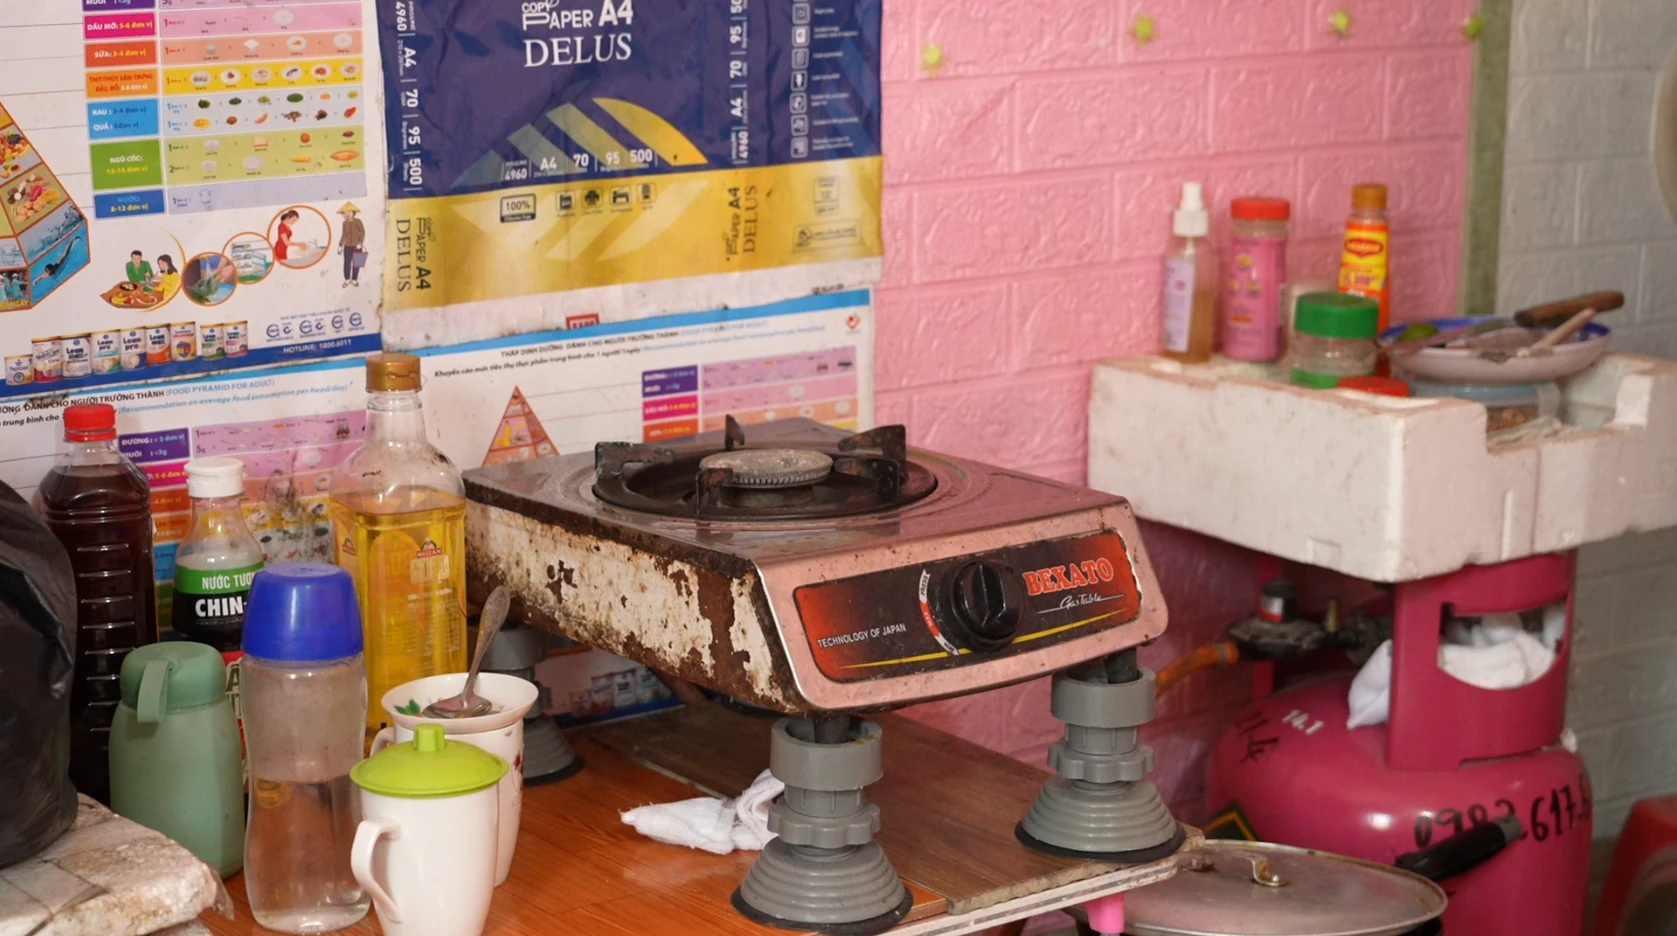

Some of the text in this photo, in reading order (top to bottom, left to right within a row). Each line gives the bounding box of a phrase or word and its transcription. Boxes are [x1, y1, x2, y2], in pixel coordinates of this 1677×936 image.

[522, 0, 634, 31] PAPER A4
[730, 25, 742, 44] 95
[404, 47, 417, 68] A4
[523, 32, 633, 67] DELUS
[729, 60, 742, 79] 70
[406, 89, 419, 108] 70
[730, 97, 743, 117] A4
[408, 126, 421, 145] 95
[540, 157, 557, 171] A4
[573, 153, 589, 167] 70
[605, 152, 620, 165] 95
[630, 149, 653, 163] 500
[409, 158, 423, 185] 500
[504, 168, 527, 181] 4960
[506, 201, 531, 211] 100%
[728, 186, 741, 209] A4
[743, 185, 758, 253] DELUS
[396, 218, 411, 292] DELUS
[415, 266, 432, 290] A4
[283, 344, 316, 353] HOTLINE:
[99, 393, 135, 403] TRƯỞNG
[136, 390, 165, 399] THÀNH
[191, 384, 230, 393] PYRAMID
[232, 382, 247, 390] FOR
[3, 418, 24, 426] trung
[202, 574, 231, 590] NƯỚC
[920, 575, 928, 596] PRESS
[1022, 557, 1114, 596] BEXATO
[817, 623, 907, 648] TECHNOLOGY OF JAPAN
